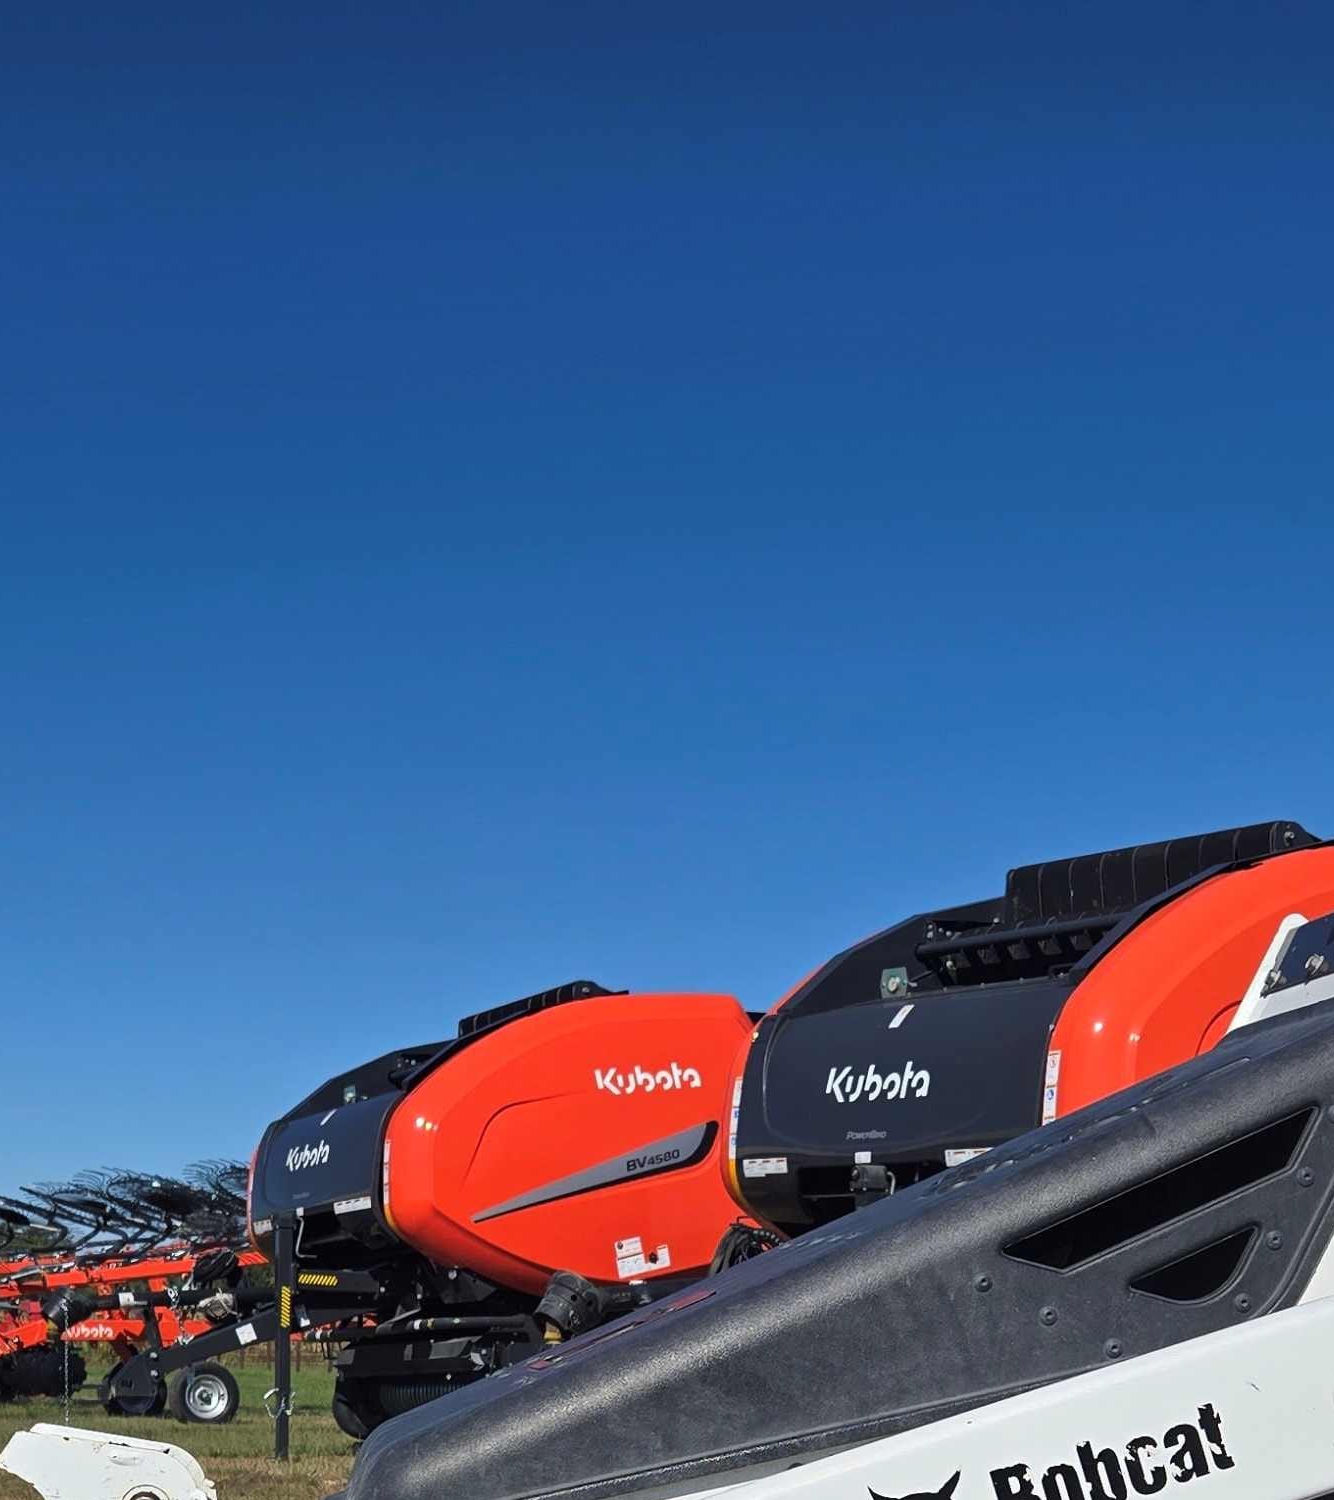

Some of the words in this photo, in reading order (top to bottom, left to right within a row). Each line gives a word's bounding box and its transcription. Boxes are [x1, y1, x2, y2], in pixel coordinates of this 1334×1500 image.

[594, 1061, 702, 1095] Kubota
[826, 1060, 930, 1103] Kubota
[285, 1139, 330, 1172] Kubota
[626, 1149, 681, 1172] BV4580
